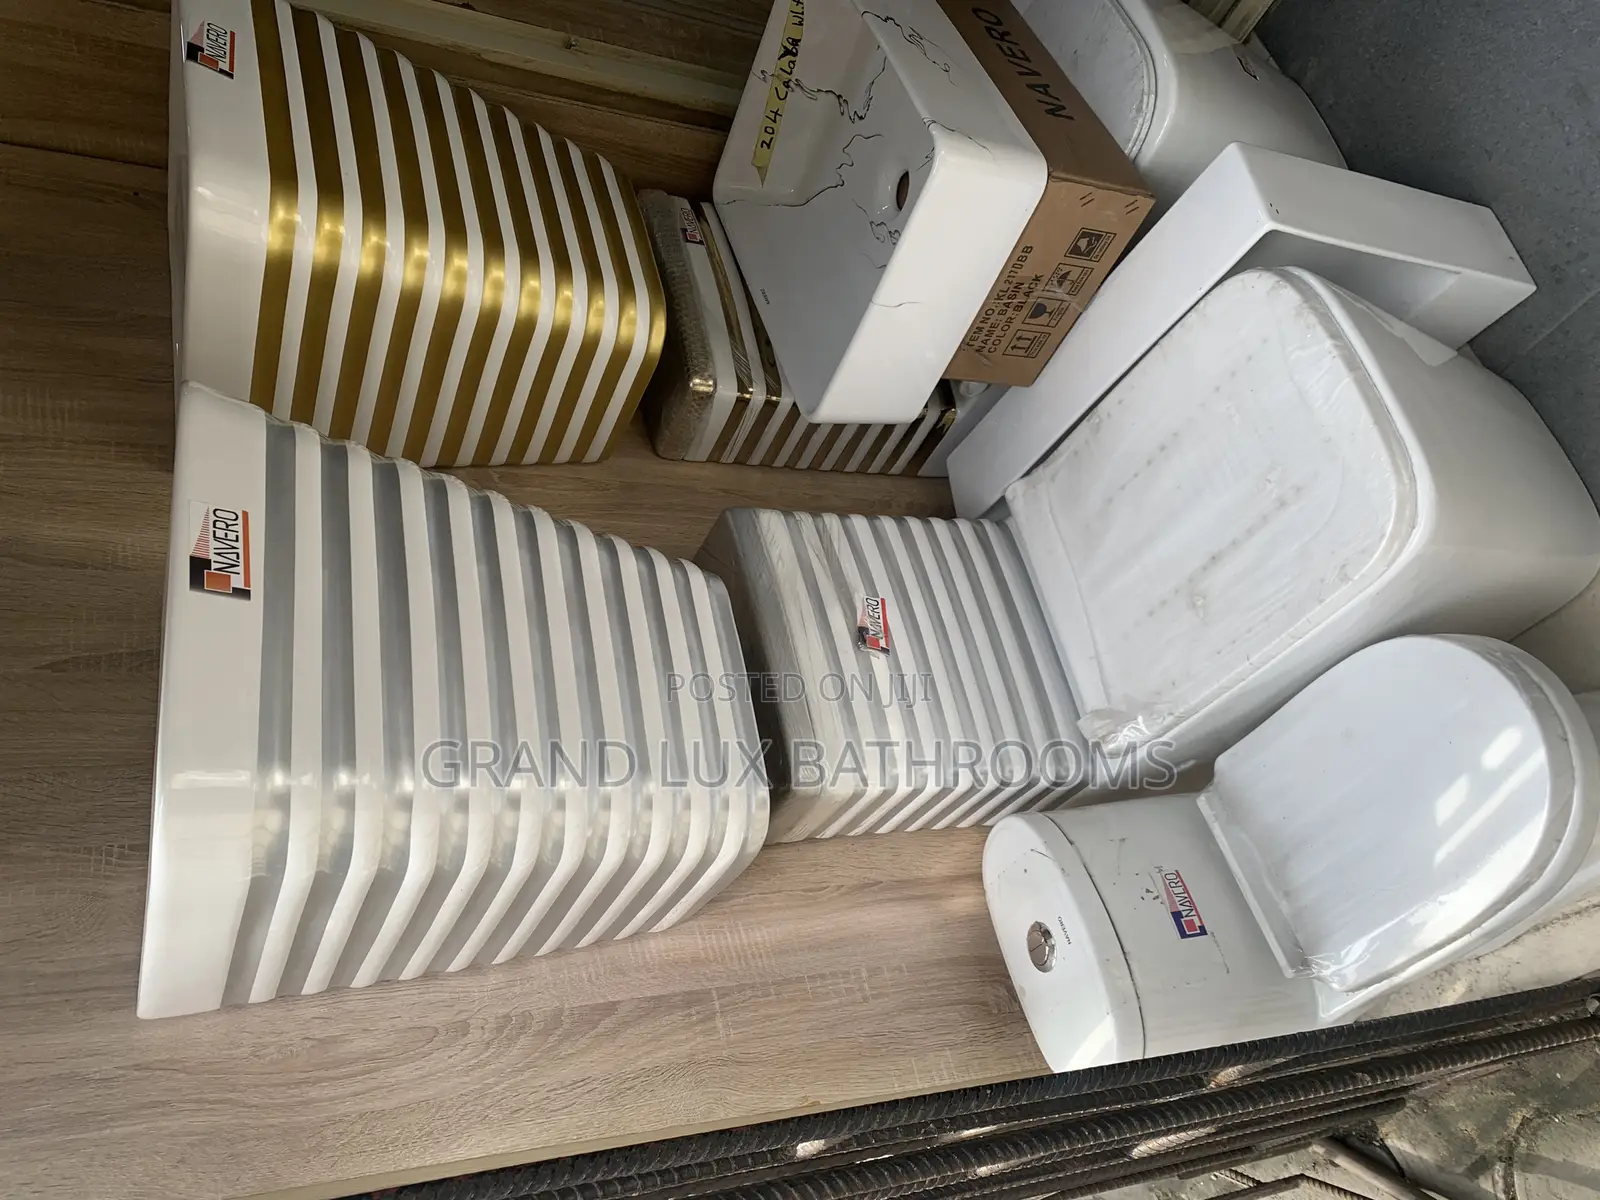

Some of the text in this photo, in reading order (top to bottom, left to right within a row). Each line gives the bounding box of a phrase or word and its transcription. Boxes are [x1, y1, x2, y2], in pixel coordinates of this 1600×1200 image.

[205, 22, 228, 63] NAVERO
[971, 7, 1076, 120] NAVERO
[760, 108, 783, 150] 204
[975, 281, 1025, 353] NAME: BASIN
[212, 507, 240, 575] NAVERO
[865, 597, 884, 640] NAVERO
[1163, 871, 1197, 918] NAVERO
